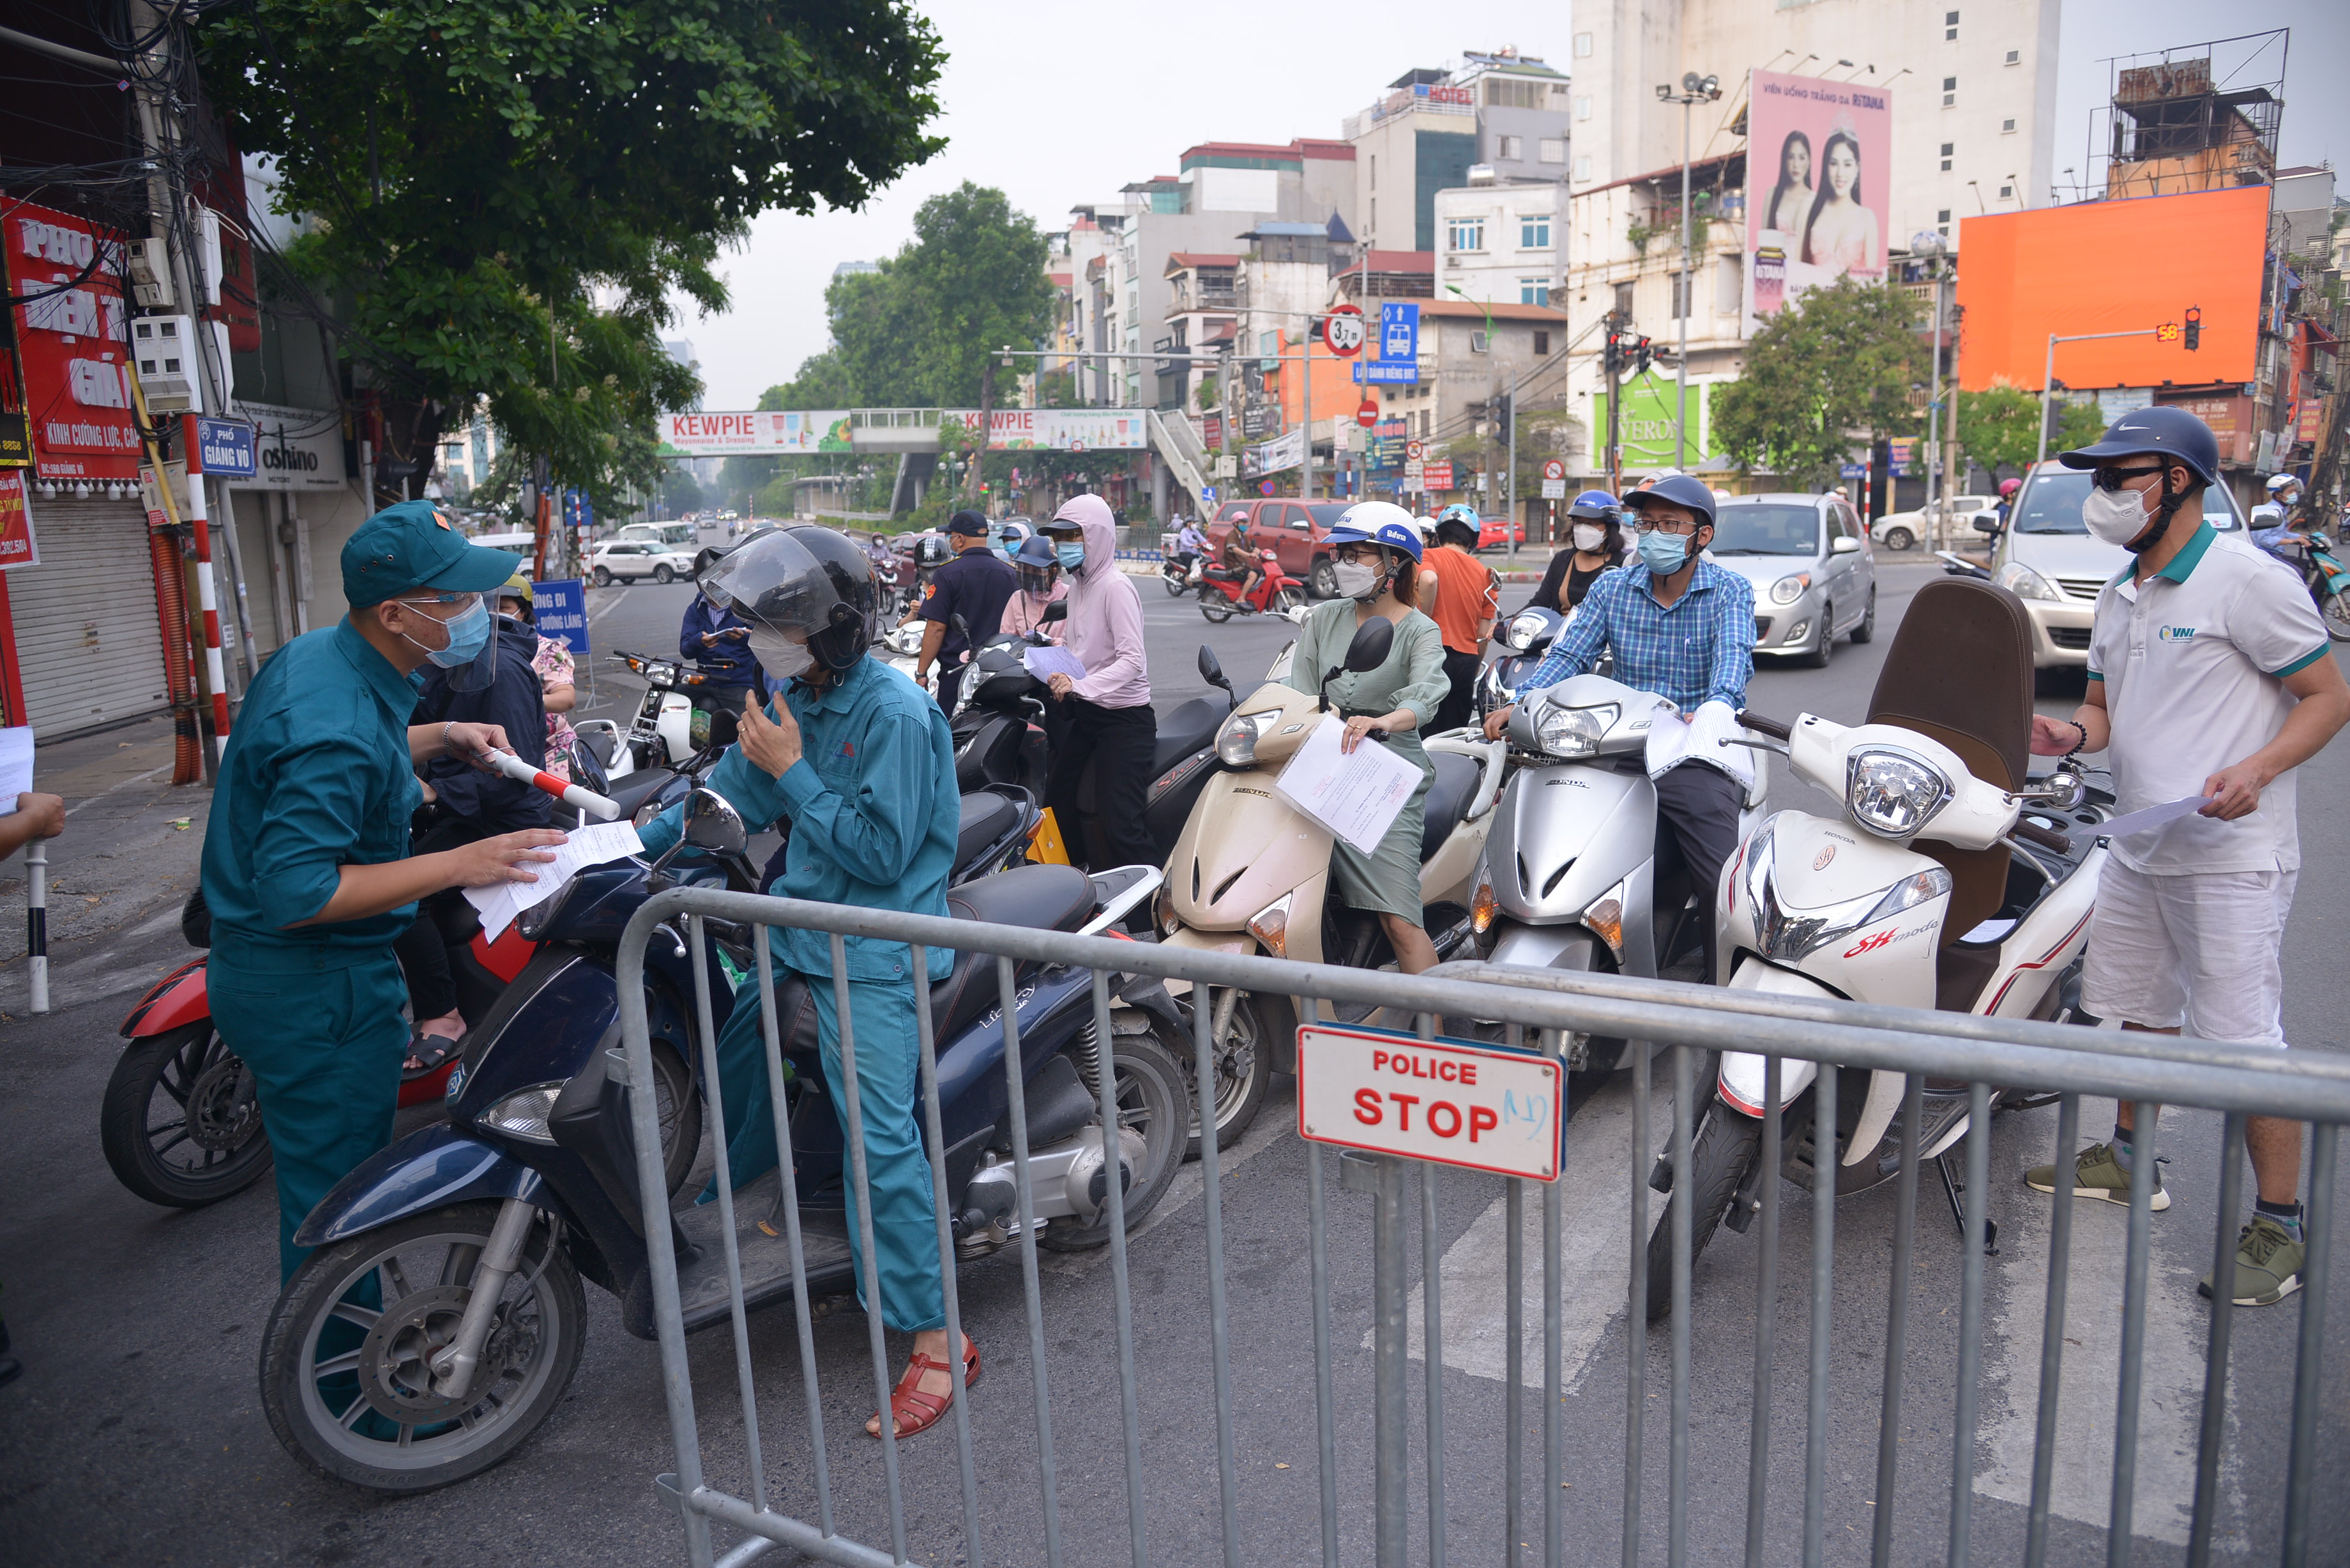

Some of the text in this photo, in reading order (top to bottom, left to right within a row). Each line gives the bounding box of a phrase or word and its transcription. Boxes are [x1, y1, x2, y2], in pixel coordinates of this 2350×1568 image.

[1429, 86, 1473, 104] HOTEL
[1335, 321, 1349, 342] 3,7
[2157, 324, 2178, 342] 58
[217, 426, 234, 441] PHỐ
[673, 415, 755, 435] KEWPIE
[46, 418, 71, 445] KÍNH
[72, 419, 103, 446] CƯỜNG
[103, 425, 124, 451] LỰC,
[674, 437, 715, 445] Mayonnaise
[725, 436, 756, 444] Dressing
[204, 439, 250, 468] GIẢNG VÕ
[256, 422, 319, 471] oshino
[1386, 529, 1407, 541] Bifina
[533, 591, 566, 609] ỚNG ĐI
[563, 612, 582, 629] LÁNG
[1232, 787, 1273, 799] HONDA
[1545, 779, 1591, 789] HONDA
[1823, 831, 1856, 845] HONDA
[1373, 1050, 1477, 1085] POLICE
[1353, 1087, 1498, 1143] STOP
